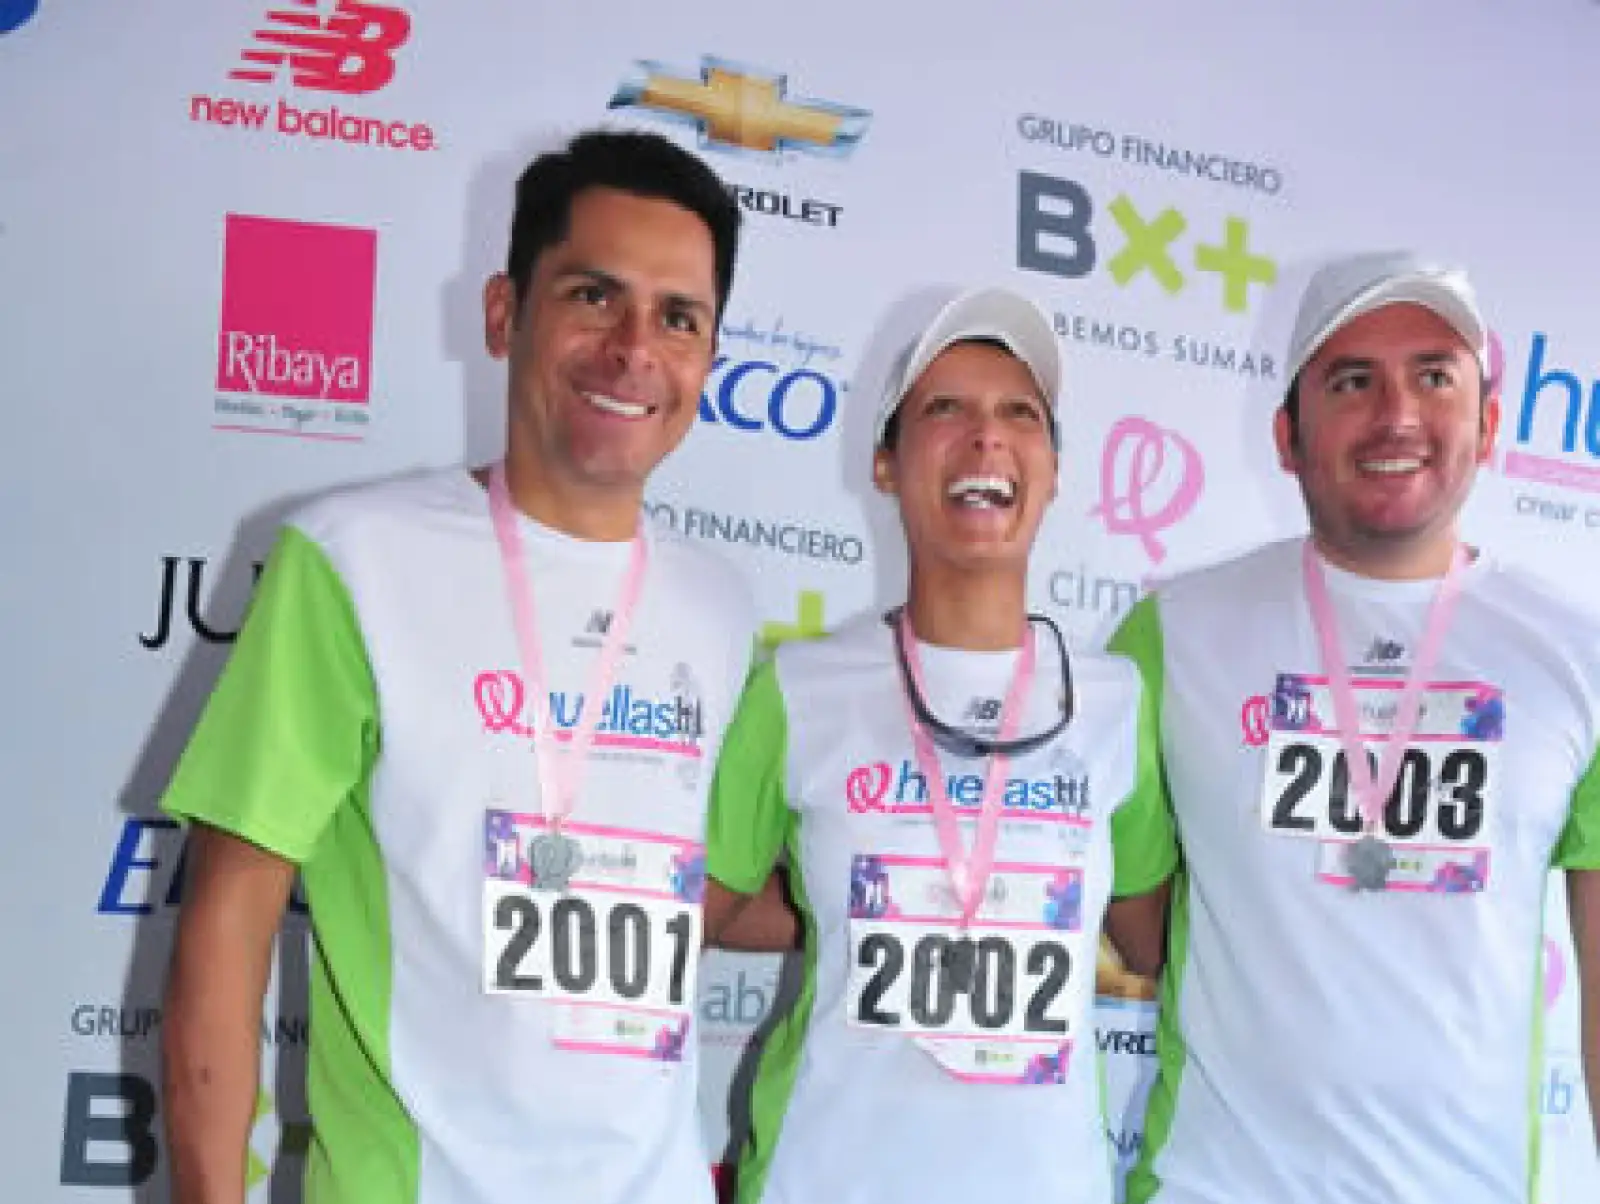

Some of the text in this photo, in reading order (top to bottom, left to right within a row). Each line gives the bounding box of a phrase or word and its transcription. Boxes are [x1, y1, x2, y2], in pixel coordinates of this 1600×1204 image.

[189, 94, 270, 130] new
[1017, 114, 1284, 196] GRUPO FINANCIERO
[733, 184, 845, 227] ROLET
[226, 330, 359, 398] Ribaya
[1052, 311, 1279, 380] BEMOS SUMAR
[684, 506, 864, 566] FINANCIERO
[493, 894, 691, 1006] 2001
[857, 931, 1074, 1033] 2002
[70, 1004, 163, 1037] GRUP
